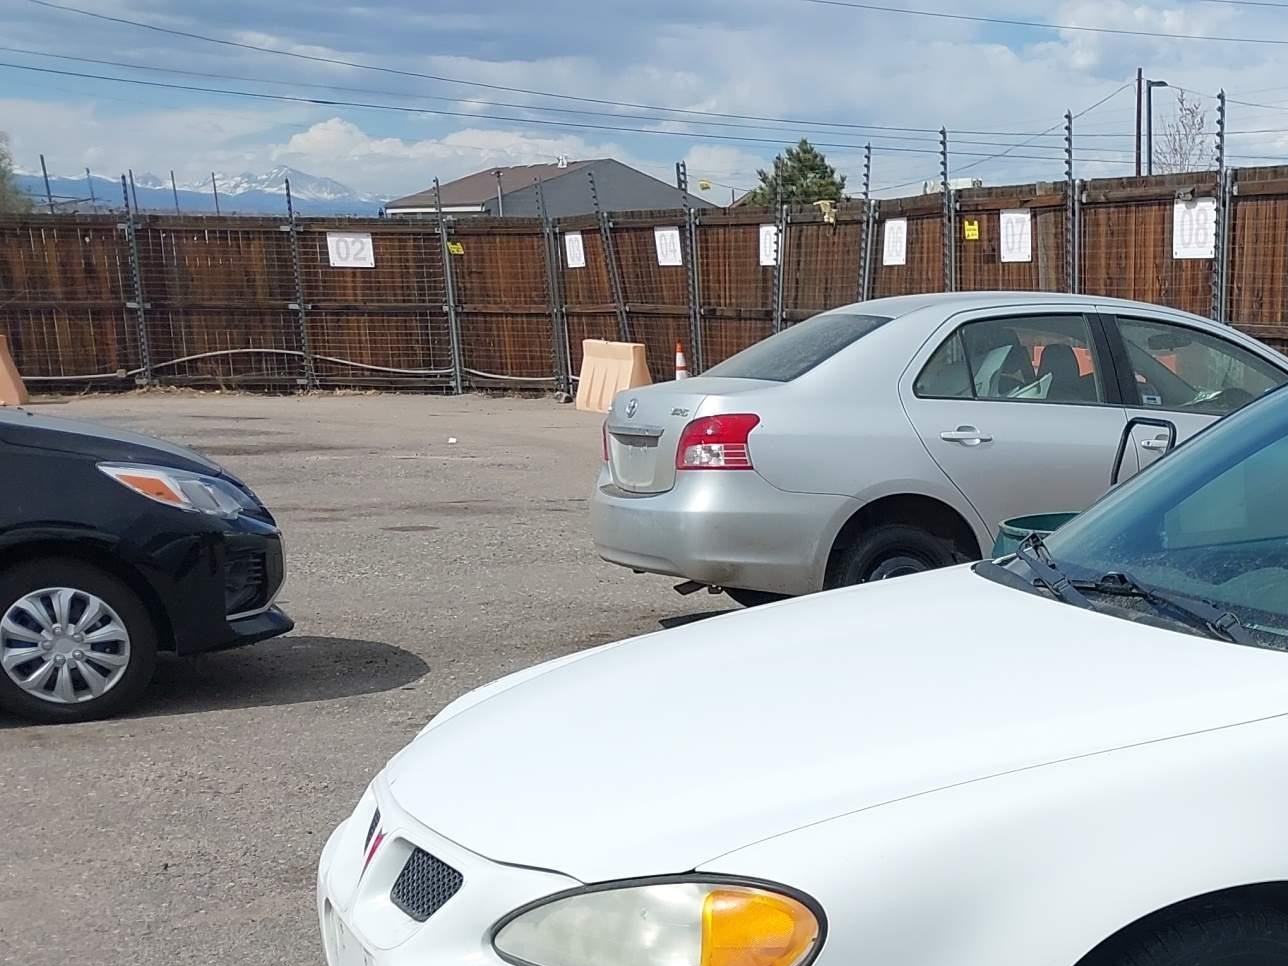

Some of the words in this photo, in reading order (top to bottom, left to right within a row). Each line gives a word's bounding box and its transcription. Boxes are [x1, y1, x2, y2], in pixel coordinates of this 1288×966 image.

[1005, 216, 1027, 252] 07
[1181, 208, 1209, 248] 08
[335, 238, 367, 262] 02
